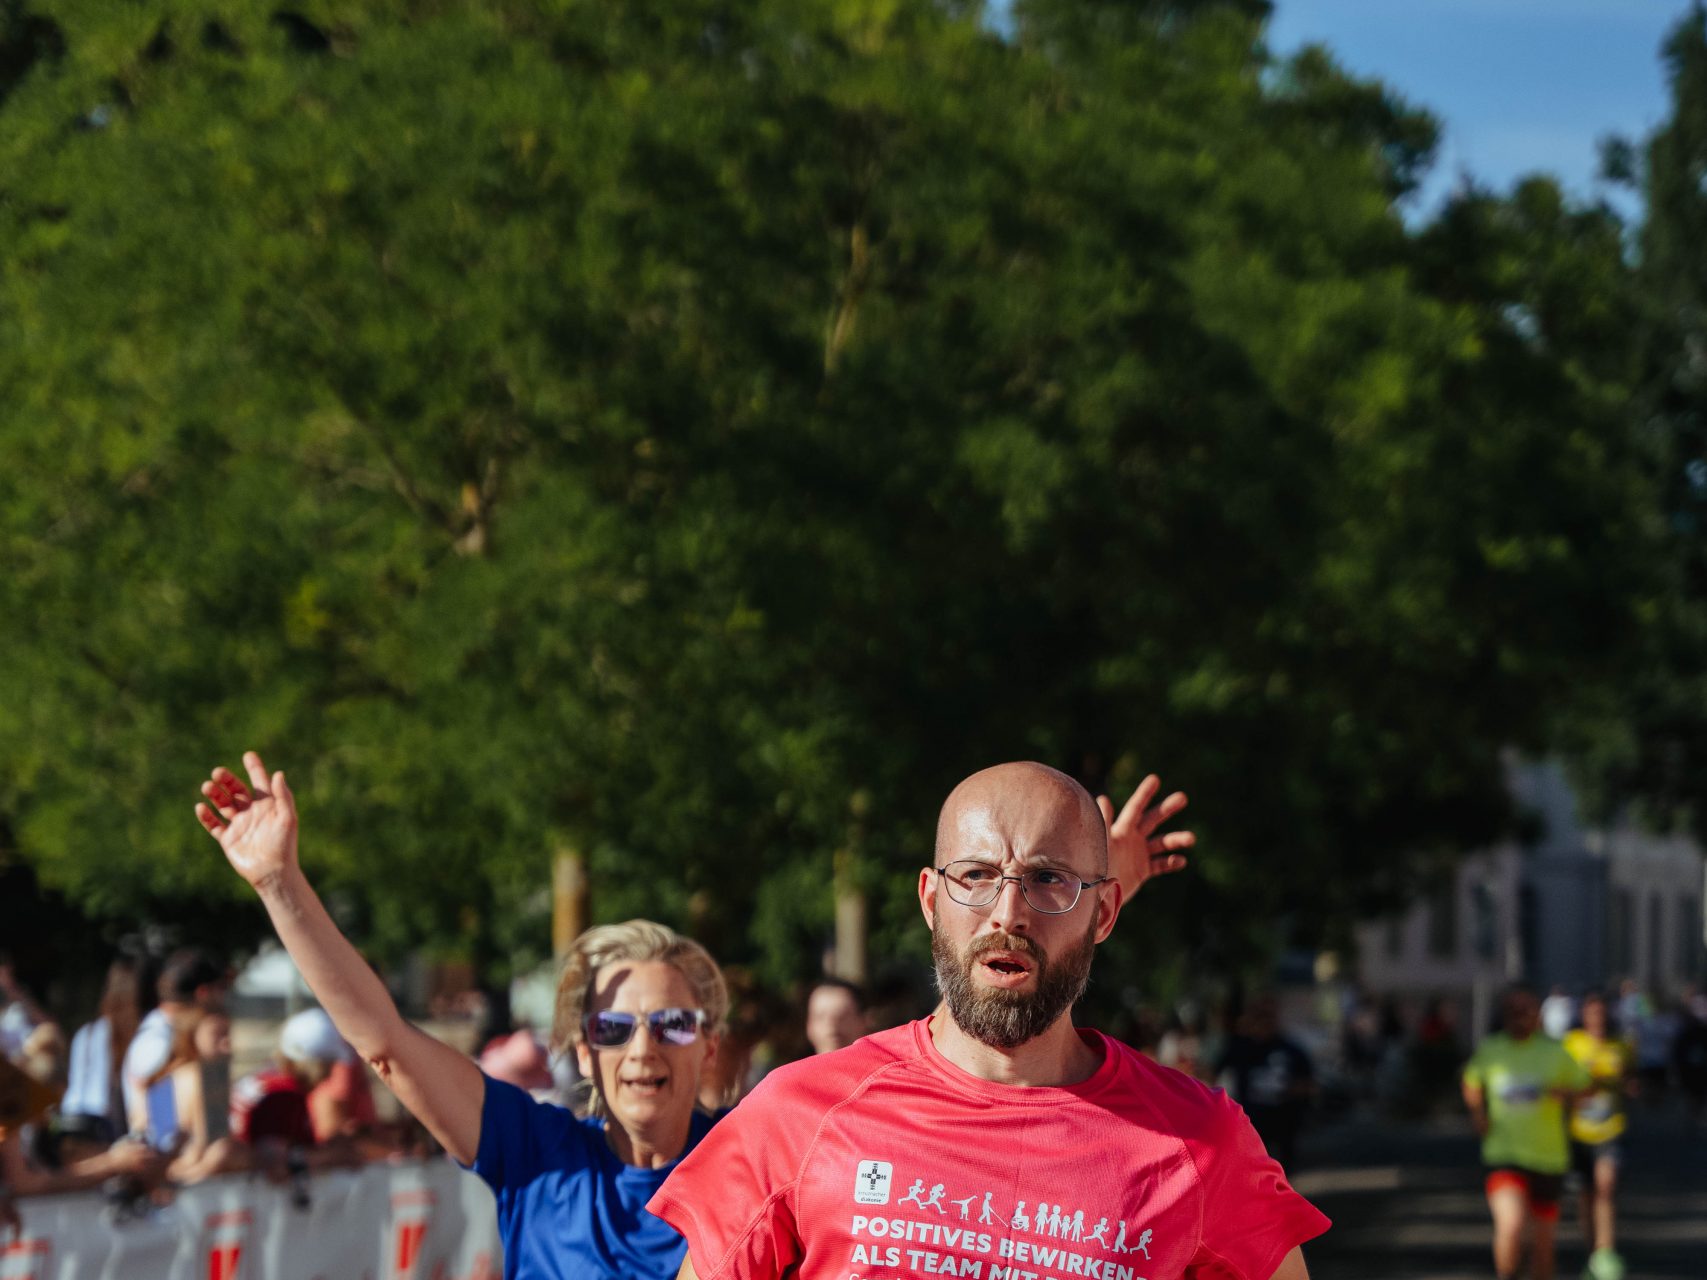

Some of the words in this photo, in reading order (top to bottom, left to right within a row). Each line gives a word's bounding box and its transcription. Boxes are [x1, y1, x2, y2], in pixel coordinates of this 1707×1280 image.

[851, 1215, 993, 1253] POSITIVES
[850, 1243, 901, 1268] ALS
[905, 1248, 983, 1280] TEAM
